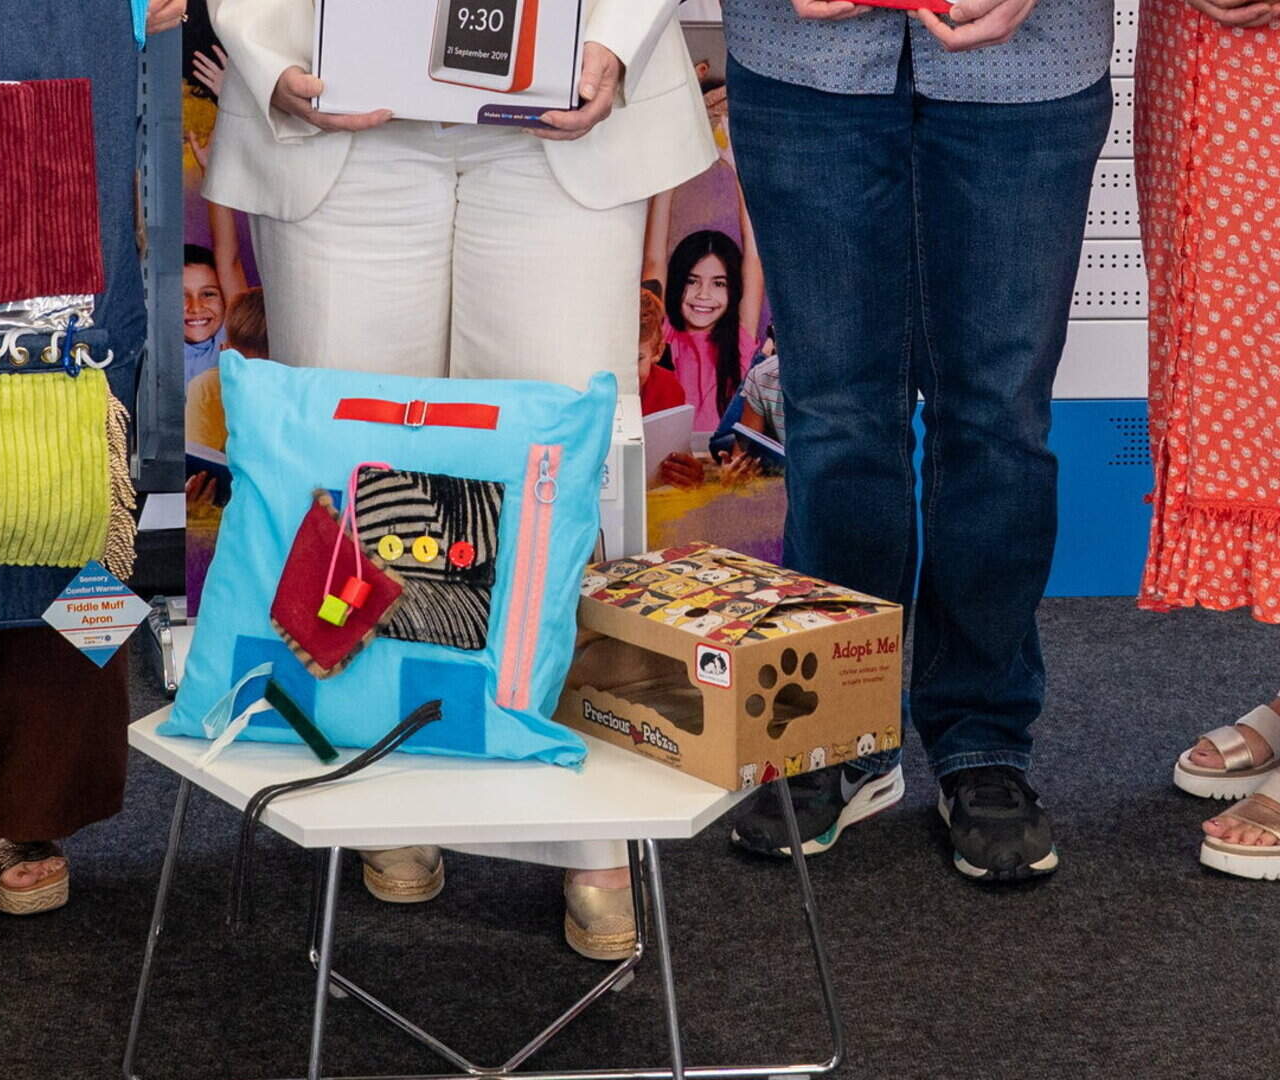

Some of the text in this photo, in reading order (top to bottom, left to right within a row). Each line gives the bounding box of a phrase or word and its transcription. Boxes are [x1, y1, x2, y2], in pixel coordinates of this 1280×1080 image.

[458, 8, 504, 32] 9:30
[454, 46, 491, 61] September
[491, 51, 508, 61] 2019
[79, 575, 108, 583] Sensory
[66, 585, 124, 595] Comfort Warmer
[67, 600, 125, 613] Fiddle Muff
[82, 616, 113, 625] Apron
[832, 634, 900, 662] Adopt Me!
[583, 699, 631, 735] Precious
